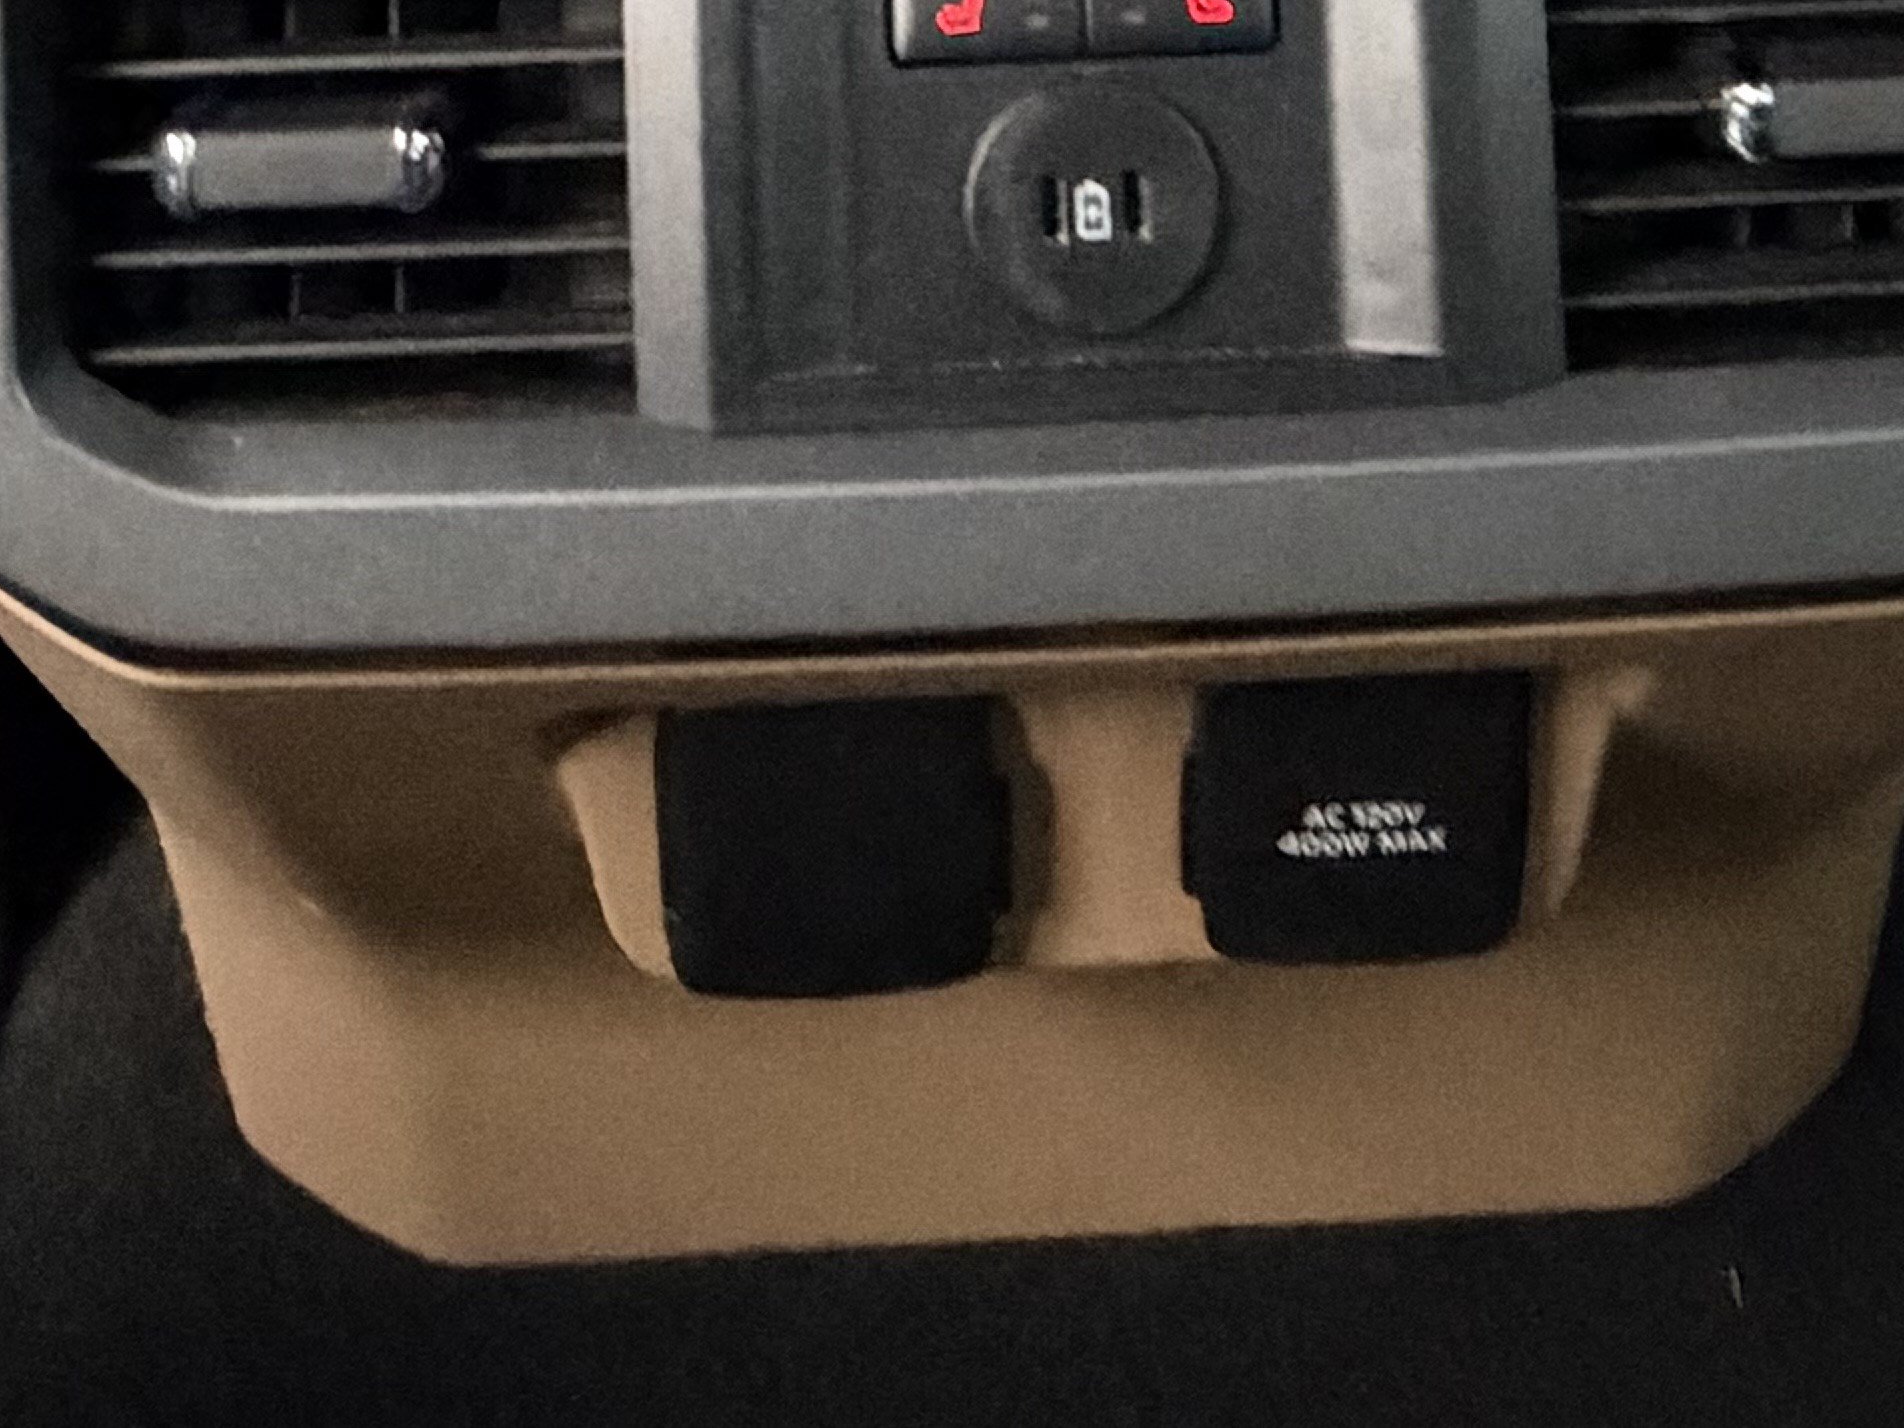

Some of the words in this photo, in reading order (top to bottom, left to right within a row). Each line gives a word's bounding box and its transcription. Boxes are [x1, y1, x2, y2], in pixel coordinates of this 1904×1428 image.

[1302, 801, 1346, 830] AC
[1349, 800, 1426, 830] 120V
[1276, 829, 1370, 858] 400W
[1374, 826, 1447, 856] MAX
